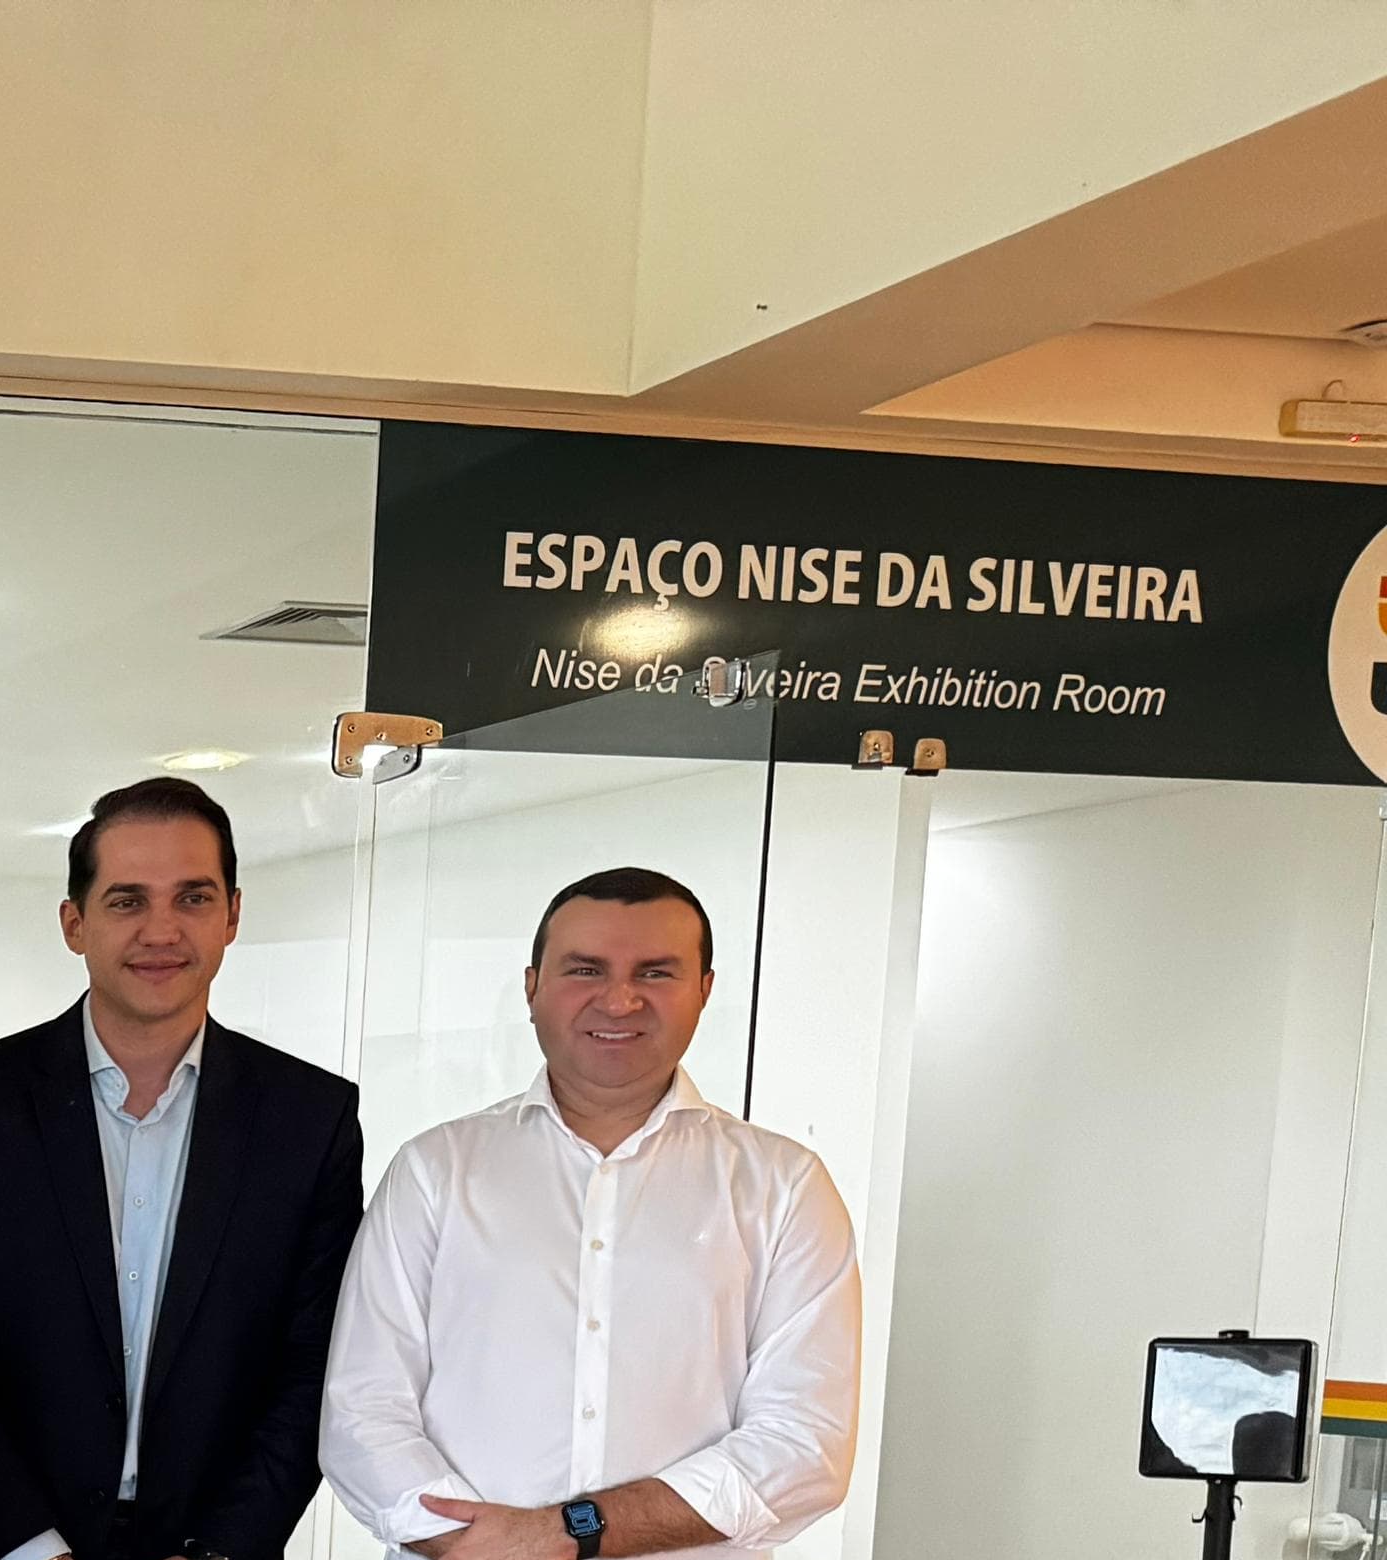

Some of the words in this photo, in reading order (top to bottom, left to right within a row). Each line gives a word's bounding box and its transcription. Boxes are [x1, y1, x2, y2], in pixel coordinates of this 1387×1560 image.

[503, 531, 723, 611] ESPAÇO
[738, 544, 862, 605] NISE
[876, 552, 952, 610] DA
[966, 557, 1203, 623] SILVEIRA
[531, 648, 621, 691] Nise
[634, 654, 683, 694] da
[701, 656, 843, 701] veira
[853, 664, 1041, 710] Exhibition
[1052, 673, 1166, 716] Room
